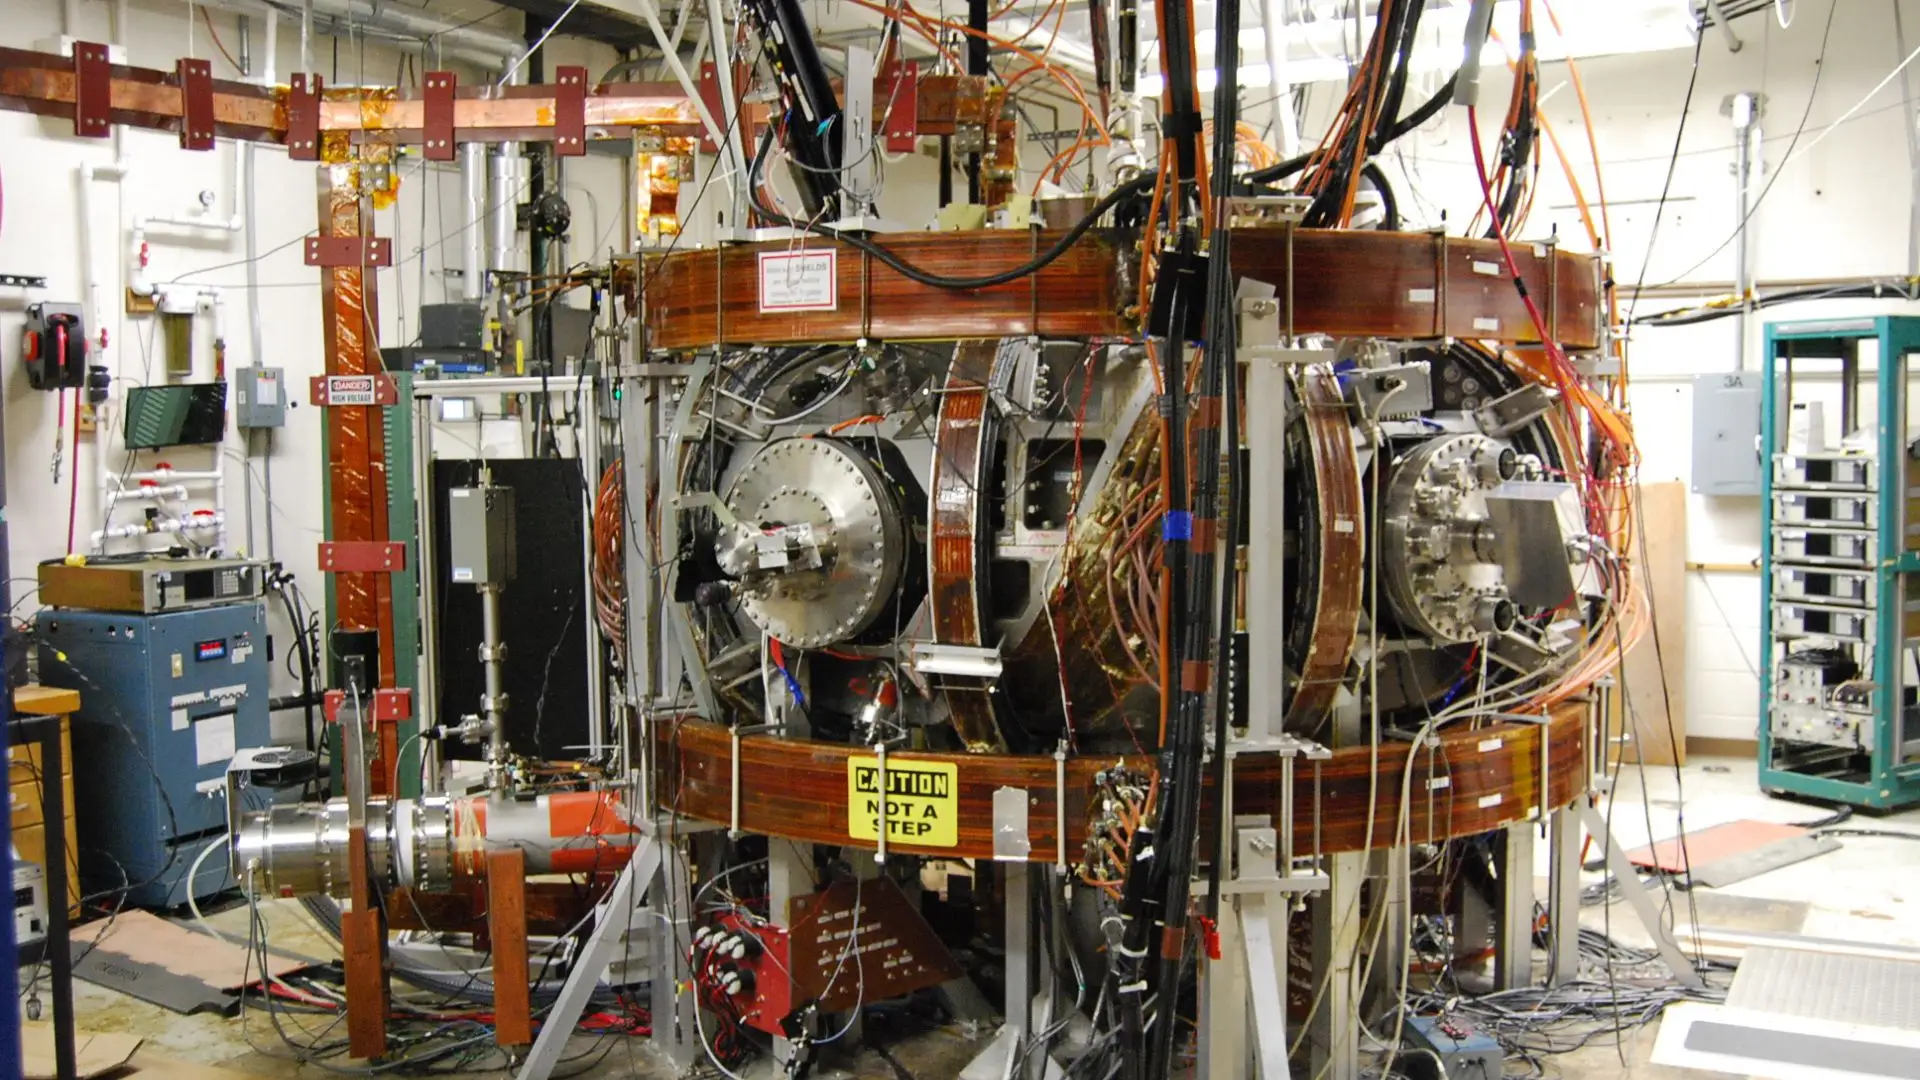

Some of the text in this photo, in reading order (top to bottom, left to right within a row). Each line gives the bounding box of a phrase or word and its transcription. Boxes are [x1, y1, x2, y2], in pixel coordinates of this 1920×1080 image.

[333, 381, 370, 390] DANGER
[1723, 375, 1744, 388] 3A
[332, 394, 371, 402] HIGH VOLTAGE
[857, 768, 947, 796] CAUTION
[867, 799, 938, 819] NOT A
[872, 818, 932, 837] STEP
